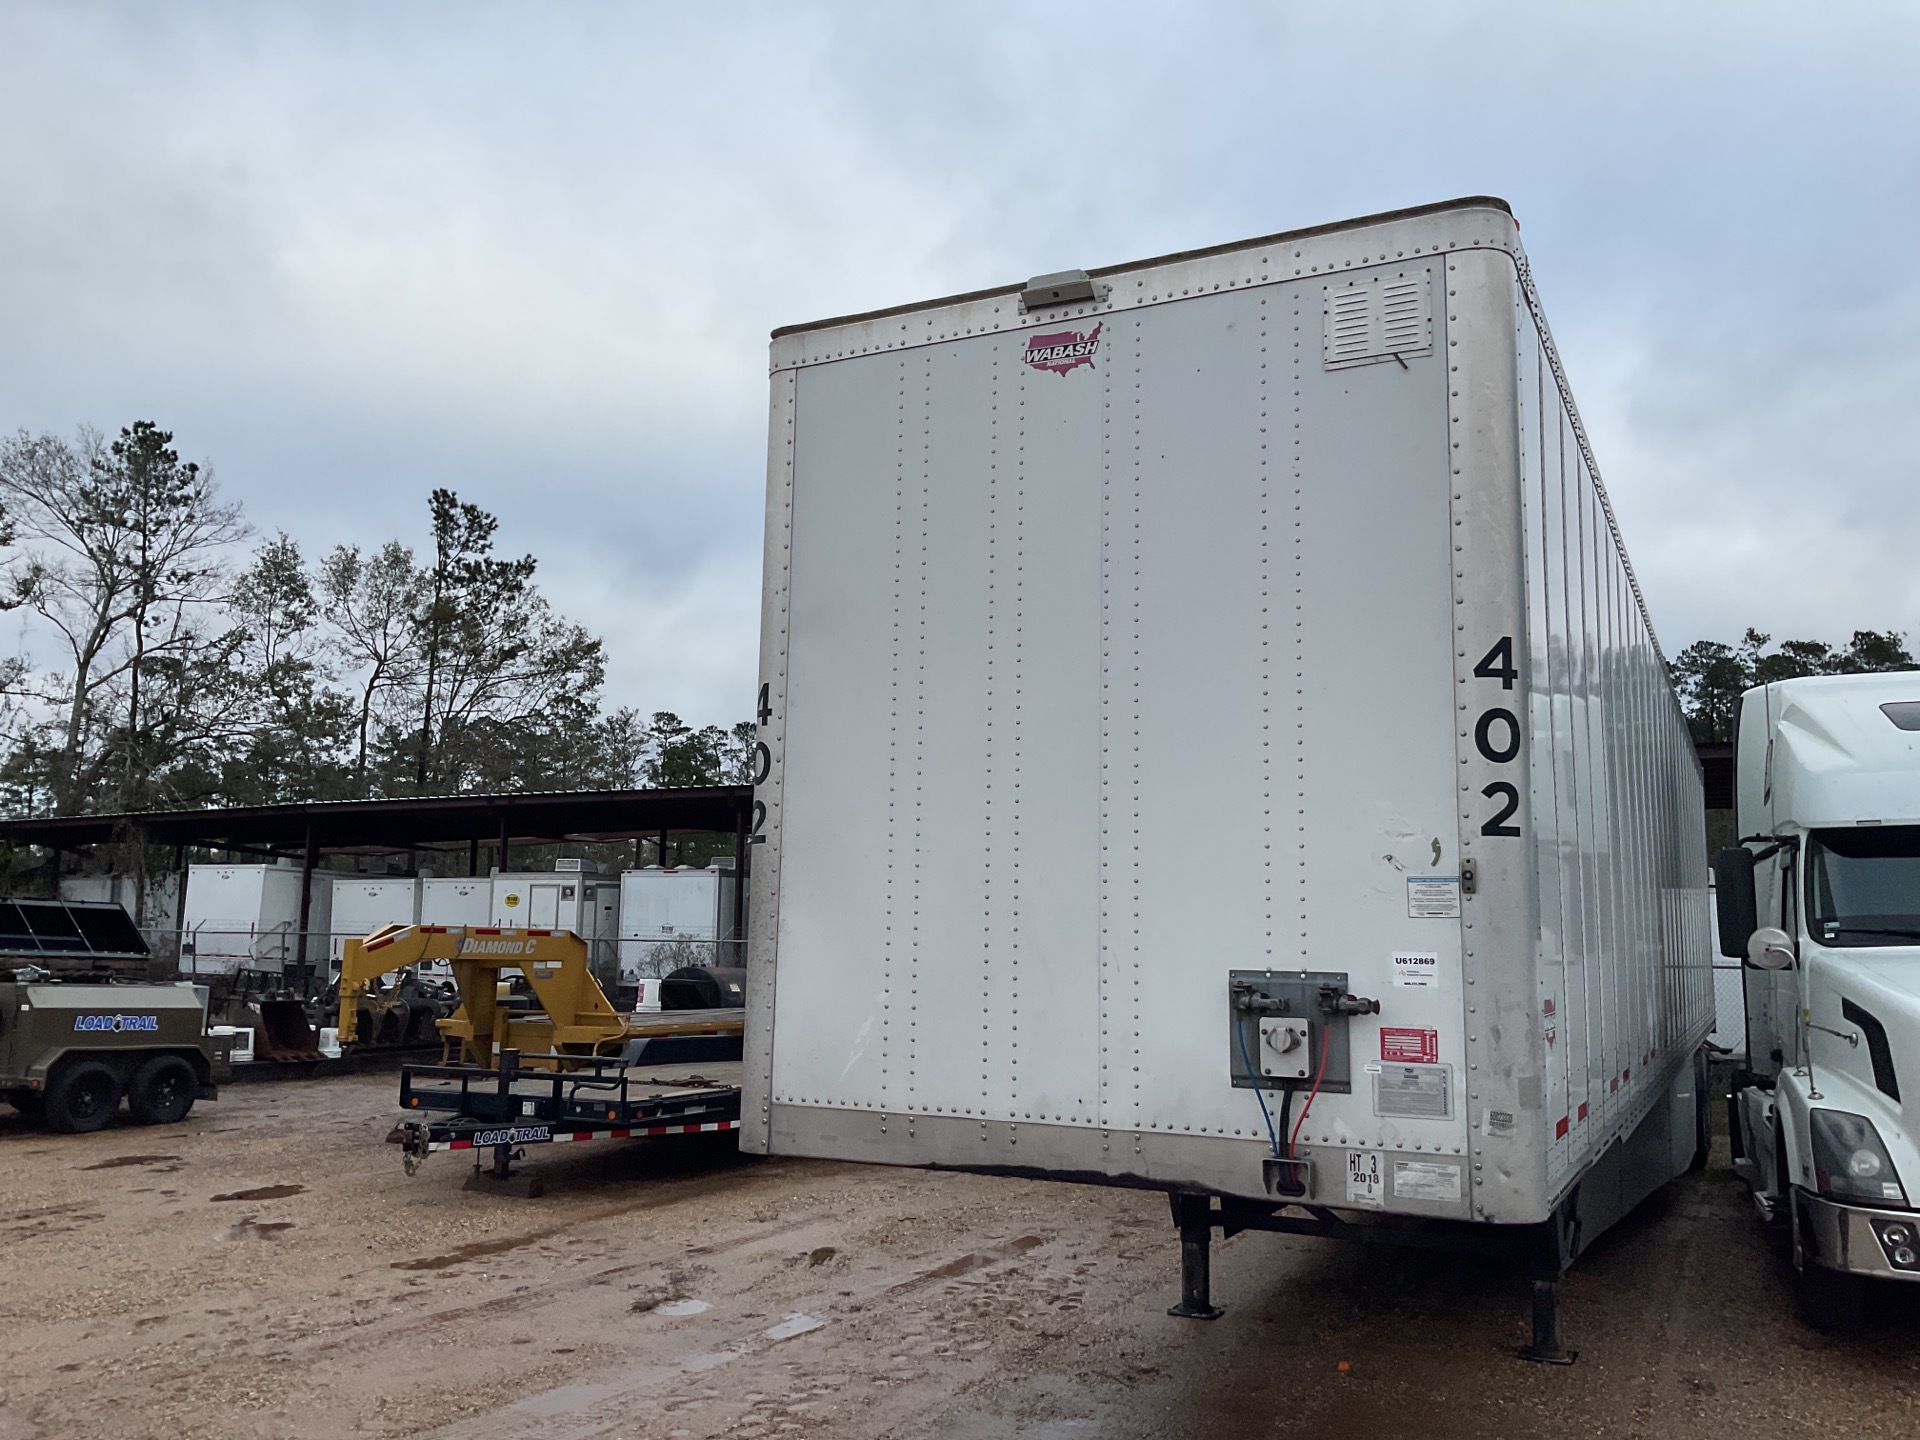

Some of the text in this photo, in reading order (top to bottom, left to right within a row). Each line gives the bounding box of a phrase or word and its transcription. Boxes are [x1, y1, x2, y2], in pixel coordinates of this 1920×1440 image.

[1026, 340, 1099, 363] WABASH
[1046, 358, 1076, 367] NATIONAL
[1473, 636, 1521, 838] 402
[525, 938, 537, 954] C
[1395, 957, 1435, 965] U612869
[74, 1015, 158, 1031] LOAD TRAIL
[473, 1126, 550, 1146] LOAD TRAIL
[1349, 1153, 1362, 1172] HT
[1370, 1154, 1377, 1174] 3
[1353, 1172, 1380, 1184] 2018
